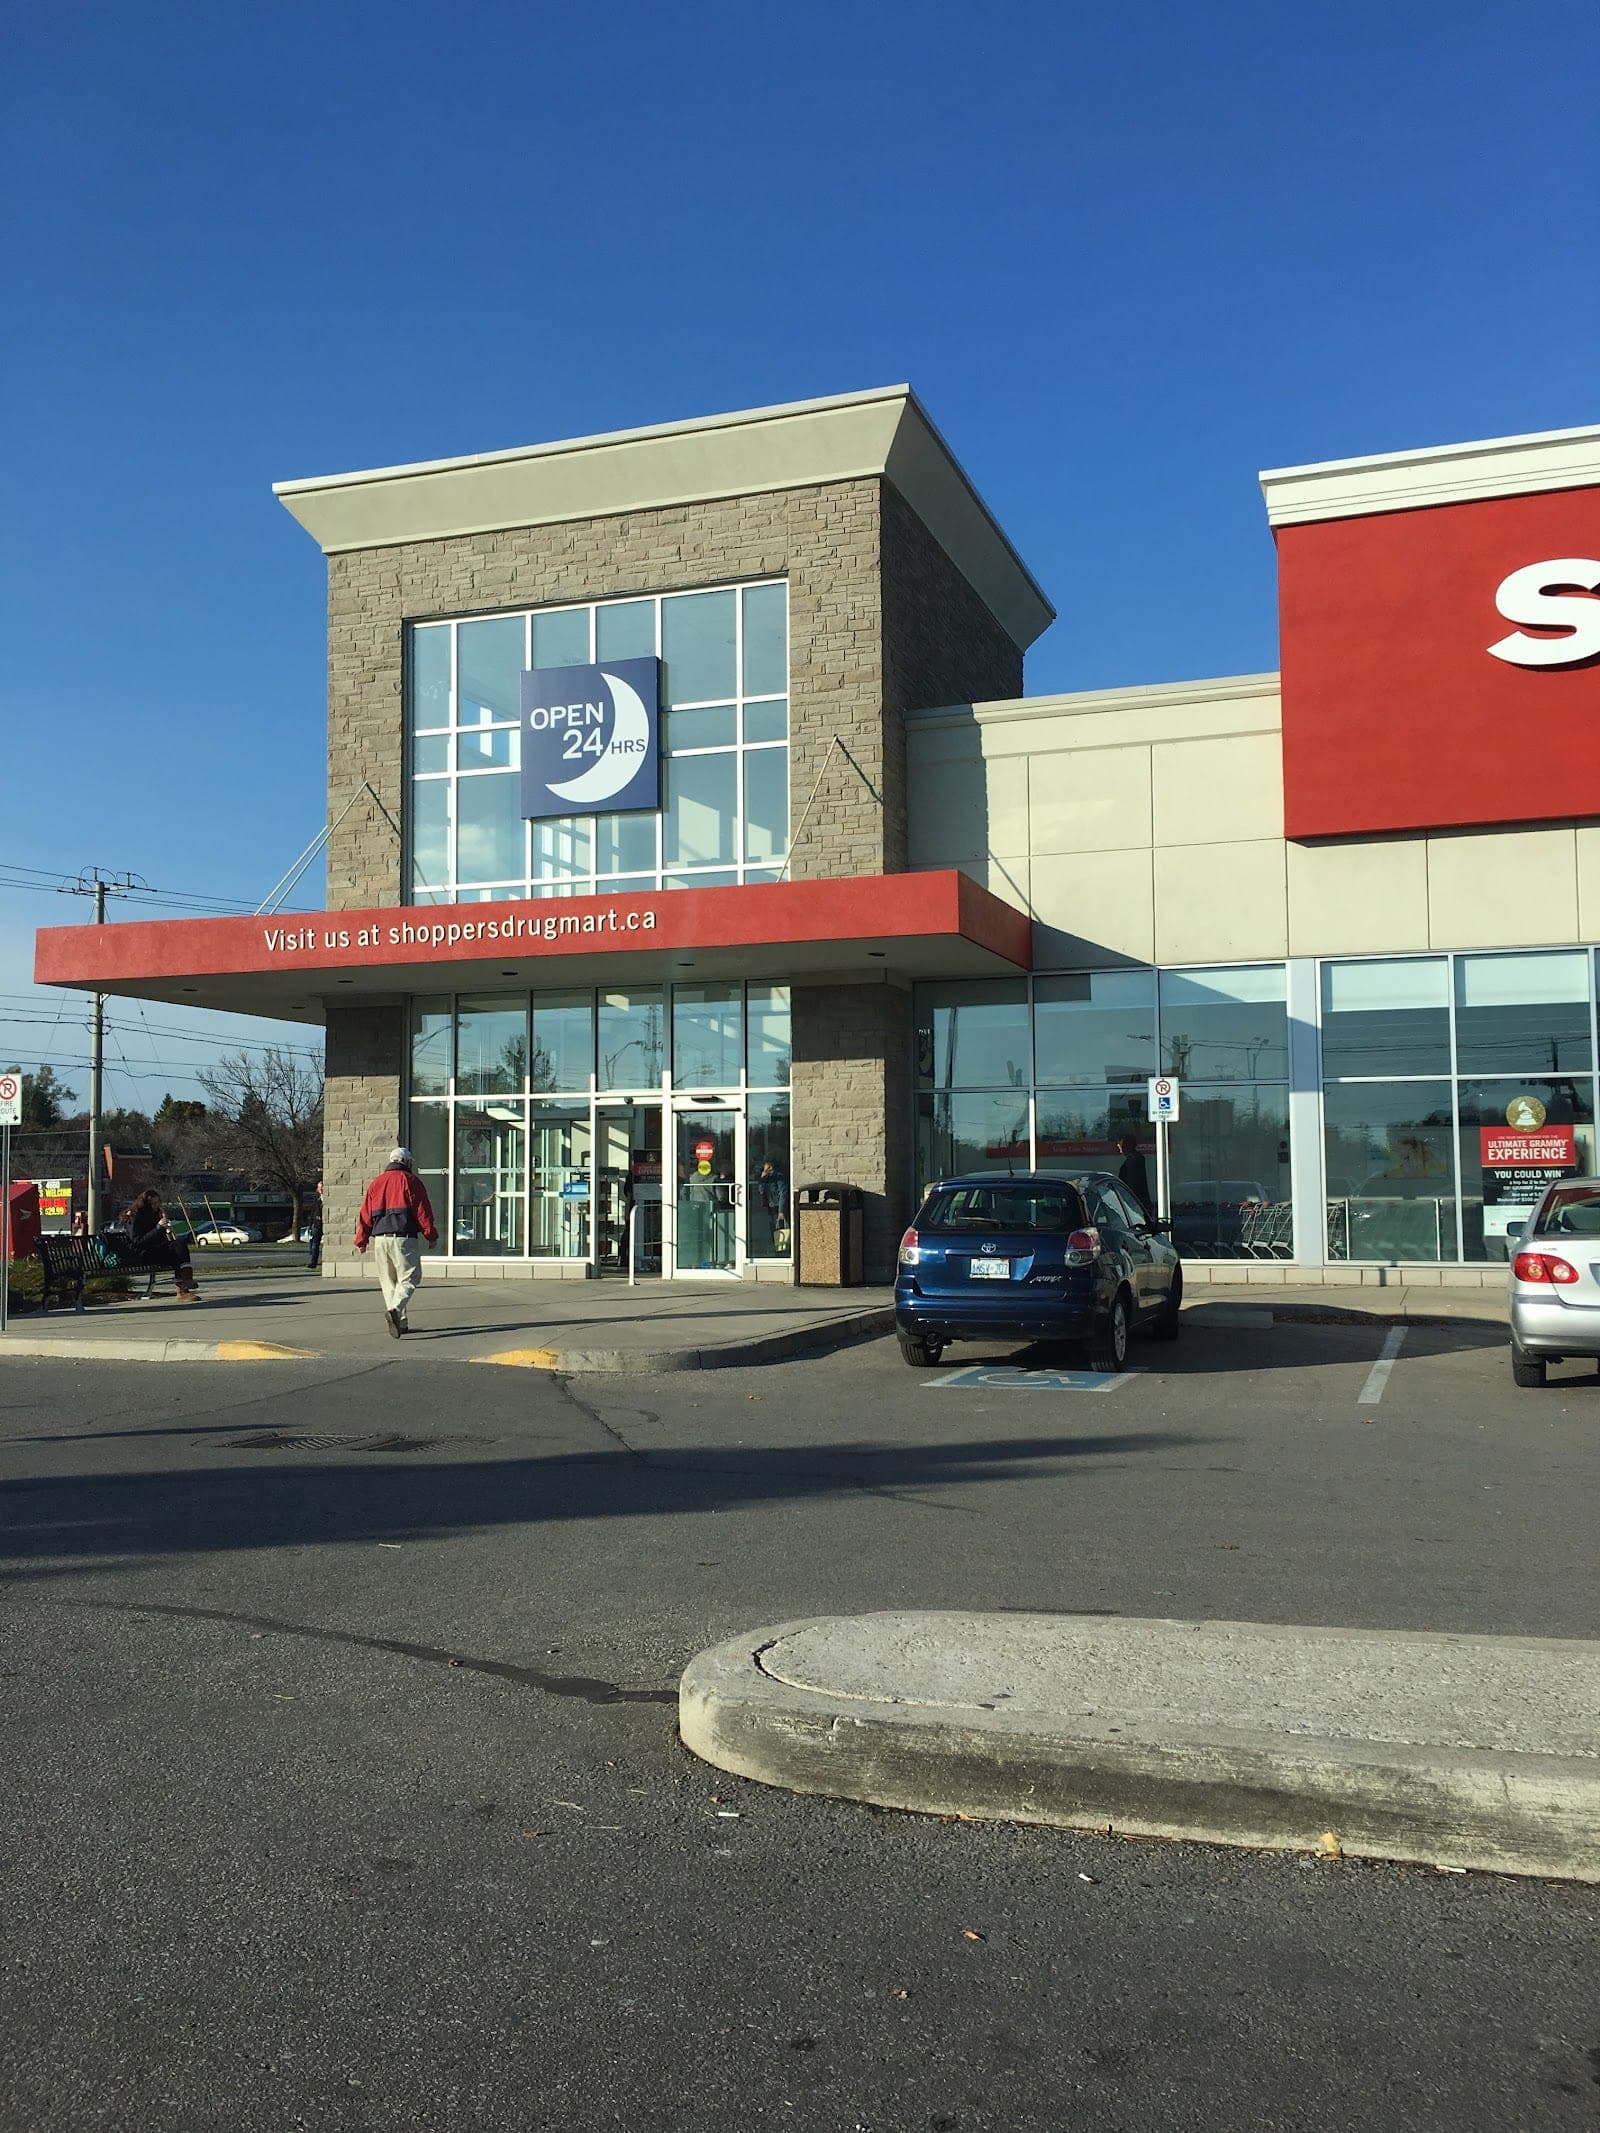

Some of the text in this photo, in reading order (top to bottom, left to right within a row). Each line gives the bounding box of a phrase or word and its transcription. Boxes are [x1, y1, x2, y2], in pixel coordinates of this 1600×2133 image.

[530, 702, 604, 730] OPEN
[562, 727, 646, 760] 24 HRS
[264, 909, 657, 951] Visit us at shoppersdrugmart.ca
[1488, 1140, 1528, 1148] ULTIMATE
[1488, 1148, 1568, 1160] EXPERIENCE
[1514, 1170, 1542, 1178] COULD
